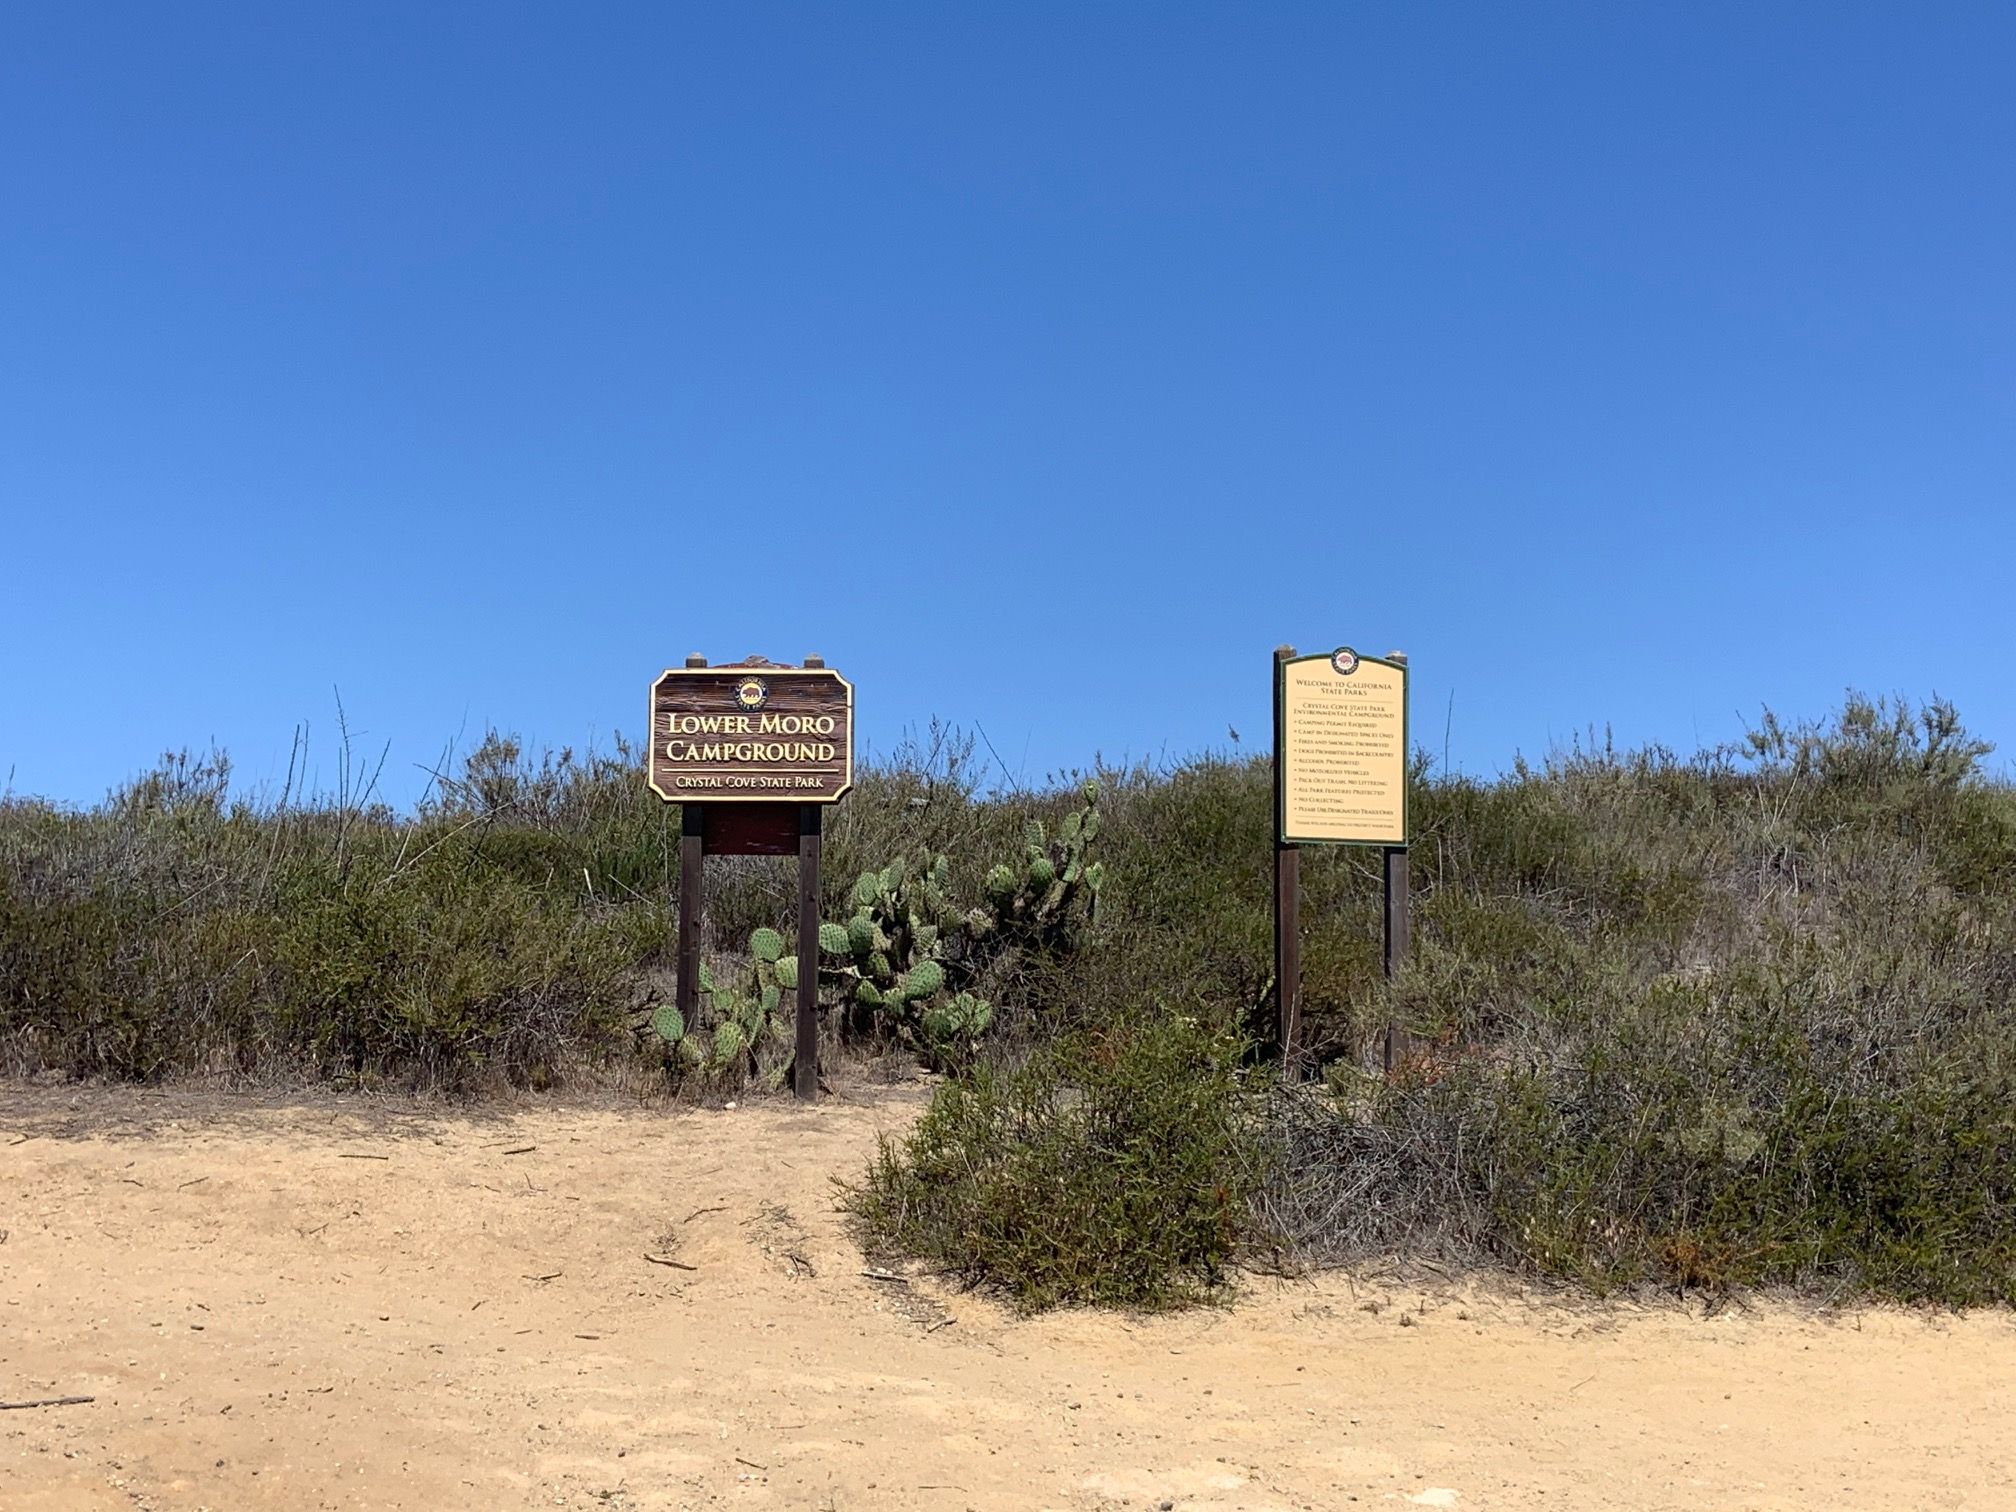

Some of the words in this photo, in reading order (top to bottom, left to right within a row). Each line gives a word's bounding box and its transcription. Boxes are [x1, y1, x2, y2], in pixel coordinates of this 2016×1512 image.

[1296, 679, 1332, 687] WELCOME
[1346, 681, 1392, 690] CALIFORNIA
[1344, 688, 1367, 696] PARKS
[1293, 709, 1347, 717] ENVIRONMENTAL
[1349, 710, 1395, 719] CAMPGROUND
[667, 713, 754, 735] LOWER
[759, 713, 835, 735] MORO
[1348, 721, 1377, 729] REQUIRED
[666, 740, 835, 762] CAMPGROUND
[1326, 758, 1360, 766] PROHIBITED
[676, 776, 723, 788] CRYSTAL
[726, 776, 757, 788] COVE
[759, 776, 792, 788] STATE
[795, 776, 824, 788] PARK
